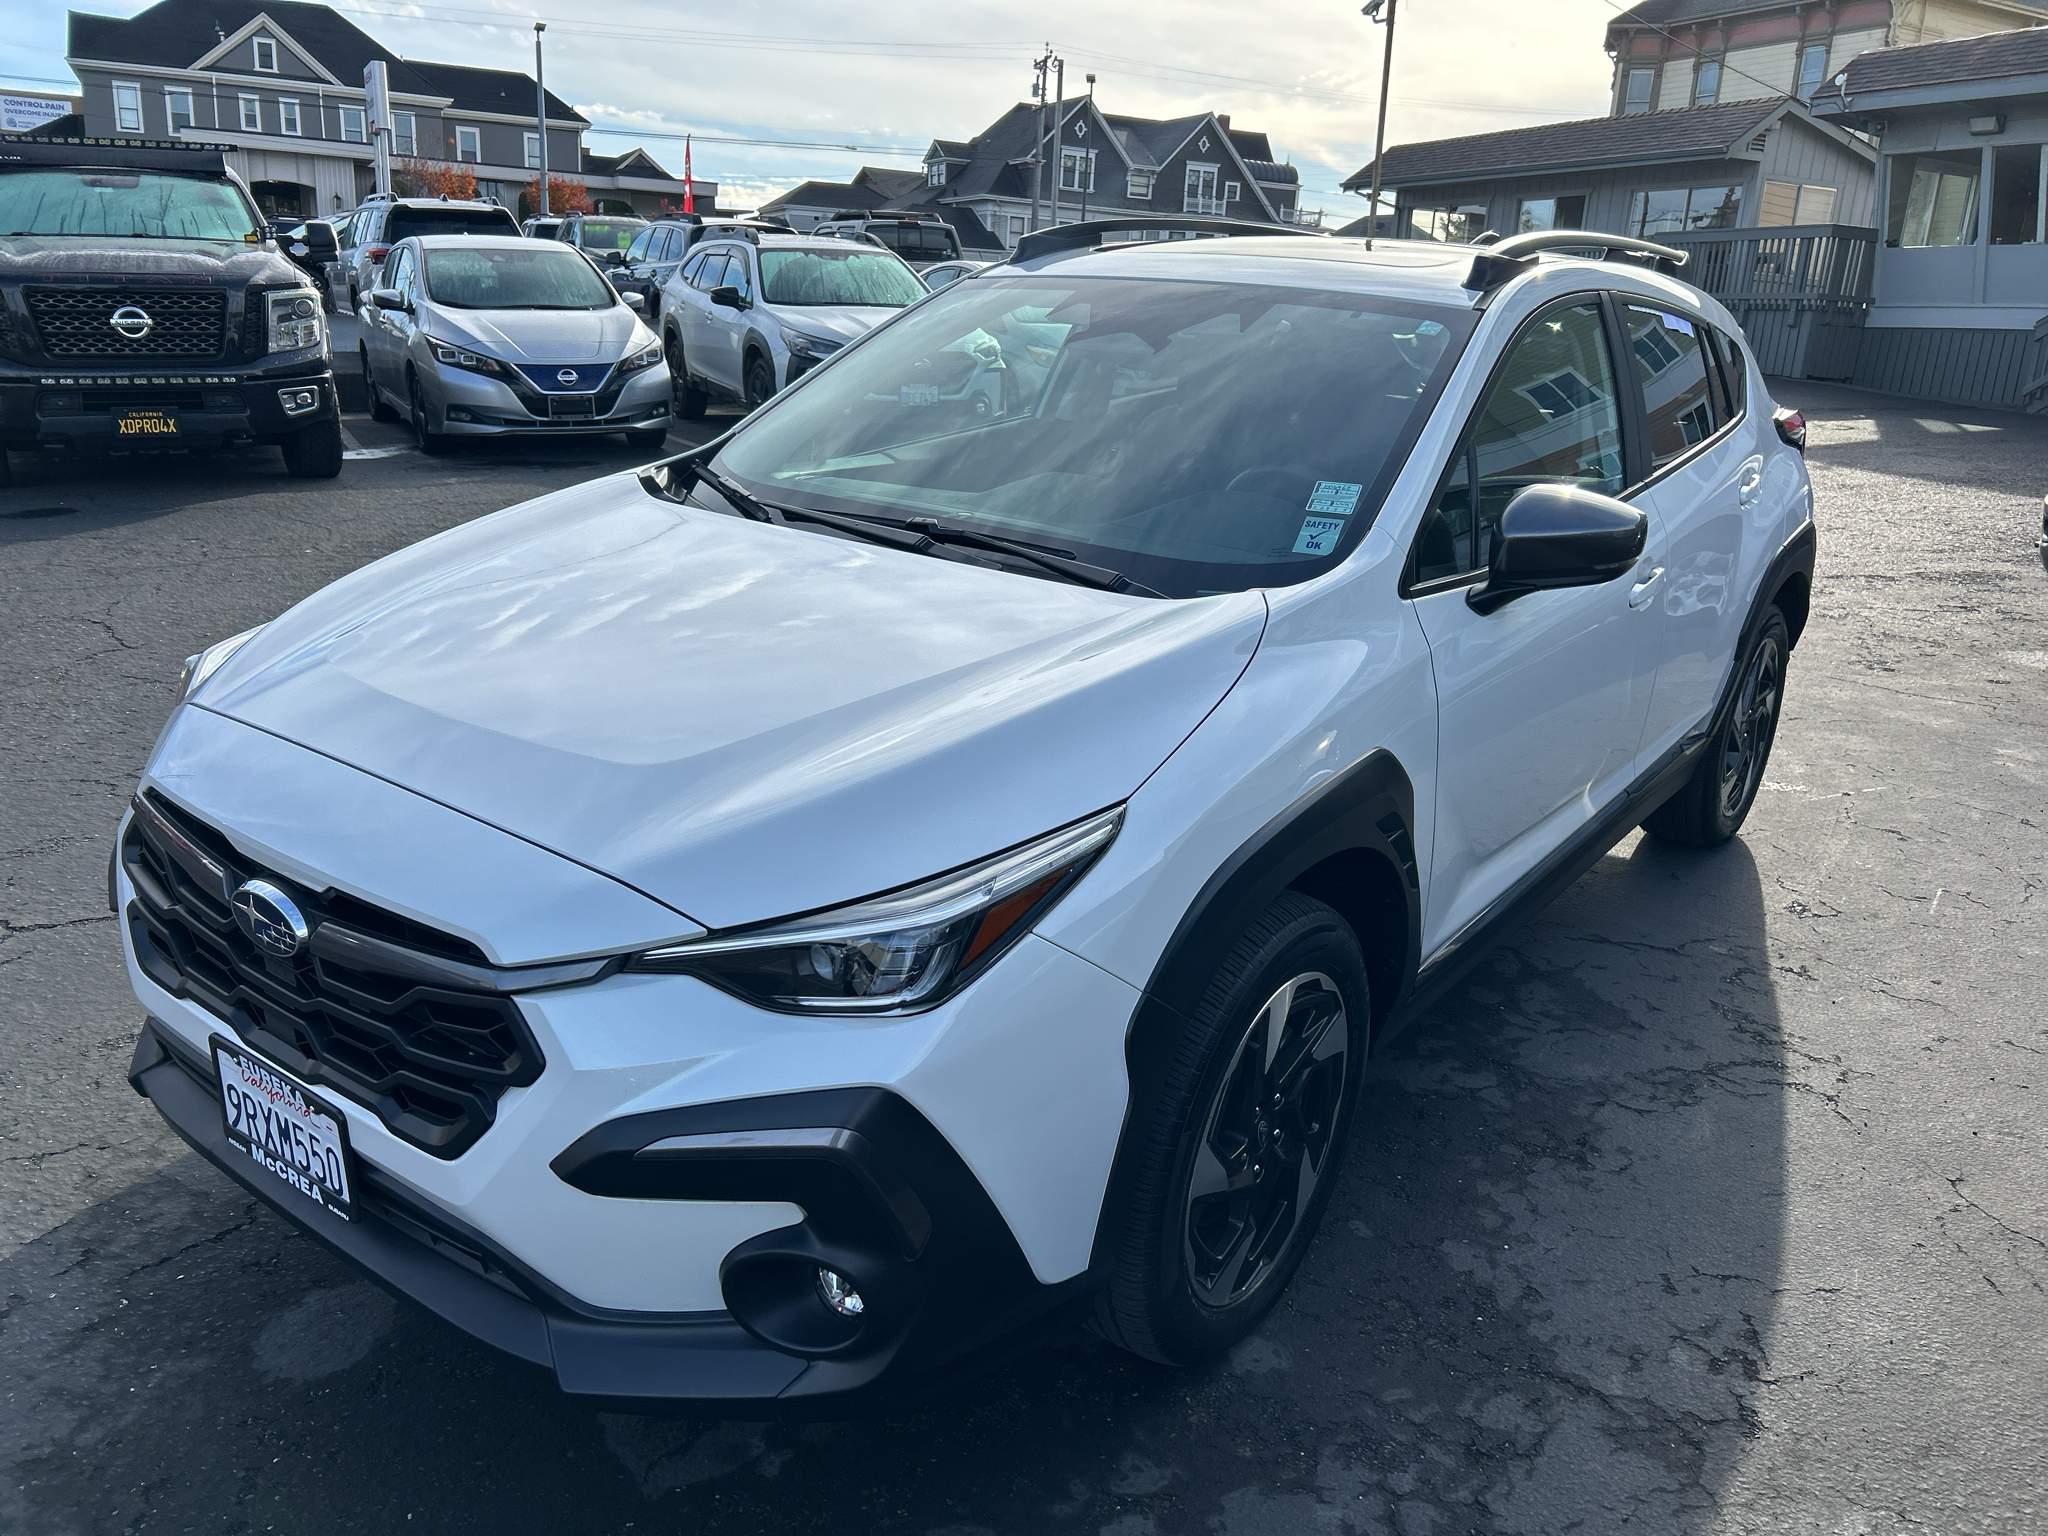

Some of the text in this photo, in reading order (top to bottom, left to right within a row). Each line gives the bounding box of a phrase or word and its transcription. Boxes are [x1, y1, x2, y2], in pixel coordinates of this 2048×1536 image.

[4, 98, 65, 111] CONTROL PAIN
[4, 108, 41, 117] OVERCOME
[1304, 520, 1340, 531] SAFETY
[1305, 540, 1323, 550] OK
[238, 1054, 305, 1106] EUREKA
[240, 1068, 321, 1130] California
[226, 1083, 344, 1197] 9RXM550
[250, 1142, 324, 1205] McCREA
